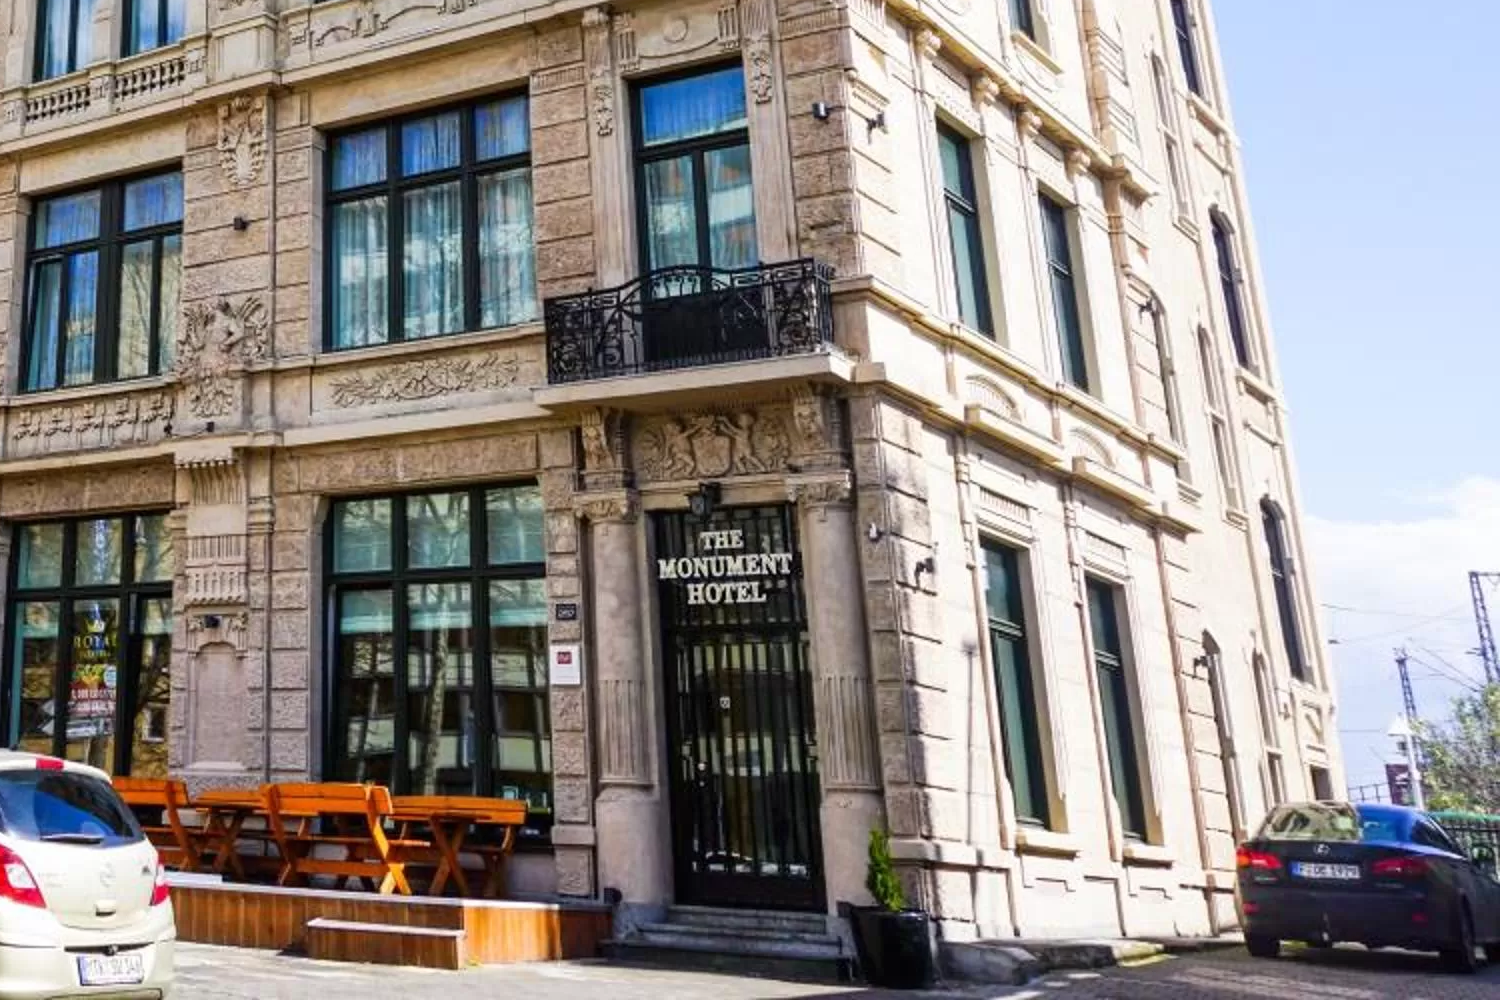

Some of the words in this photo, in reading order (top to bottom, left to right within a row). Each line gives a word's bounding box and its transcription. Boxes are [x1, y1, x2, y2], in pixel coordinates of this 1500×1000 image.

[700, 529, 744, 549] THE
[657, 553, 792, 579] MONUMENT
[687, 581, 767, 605] HOTEL
